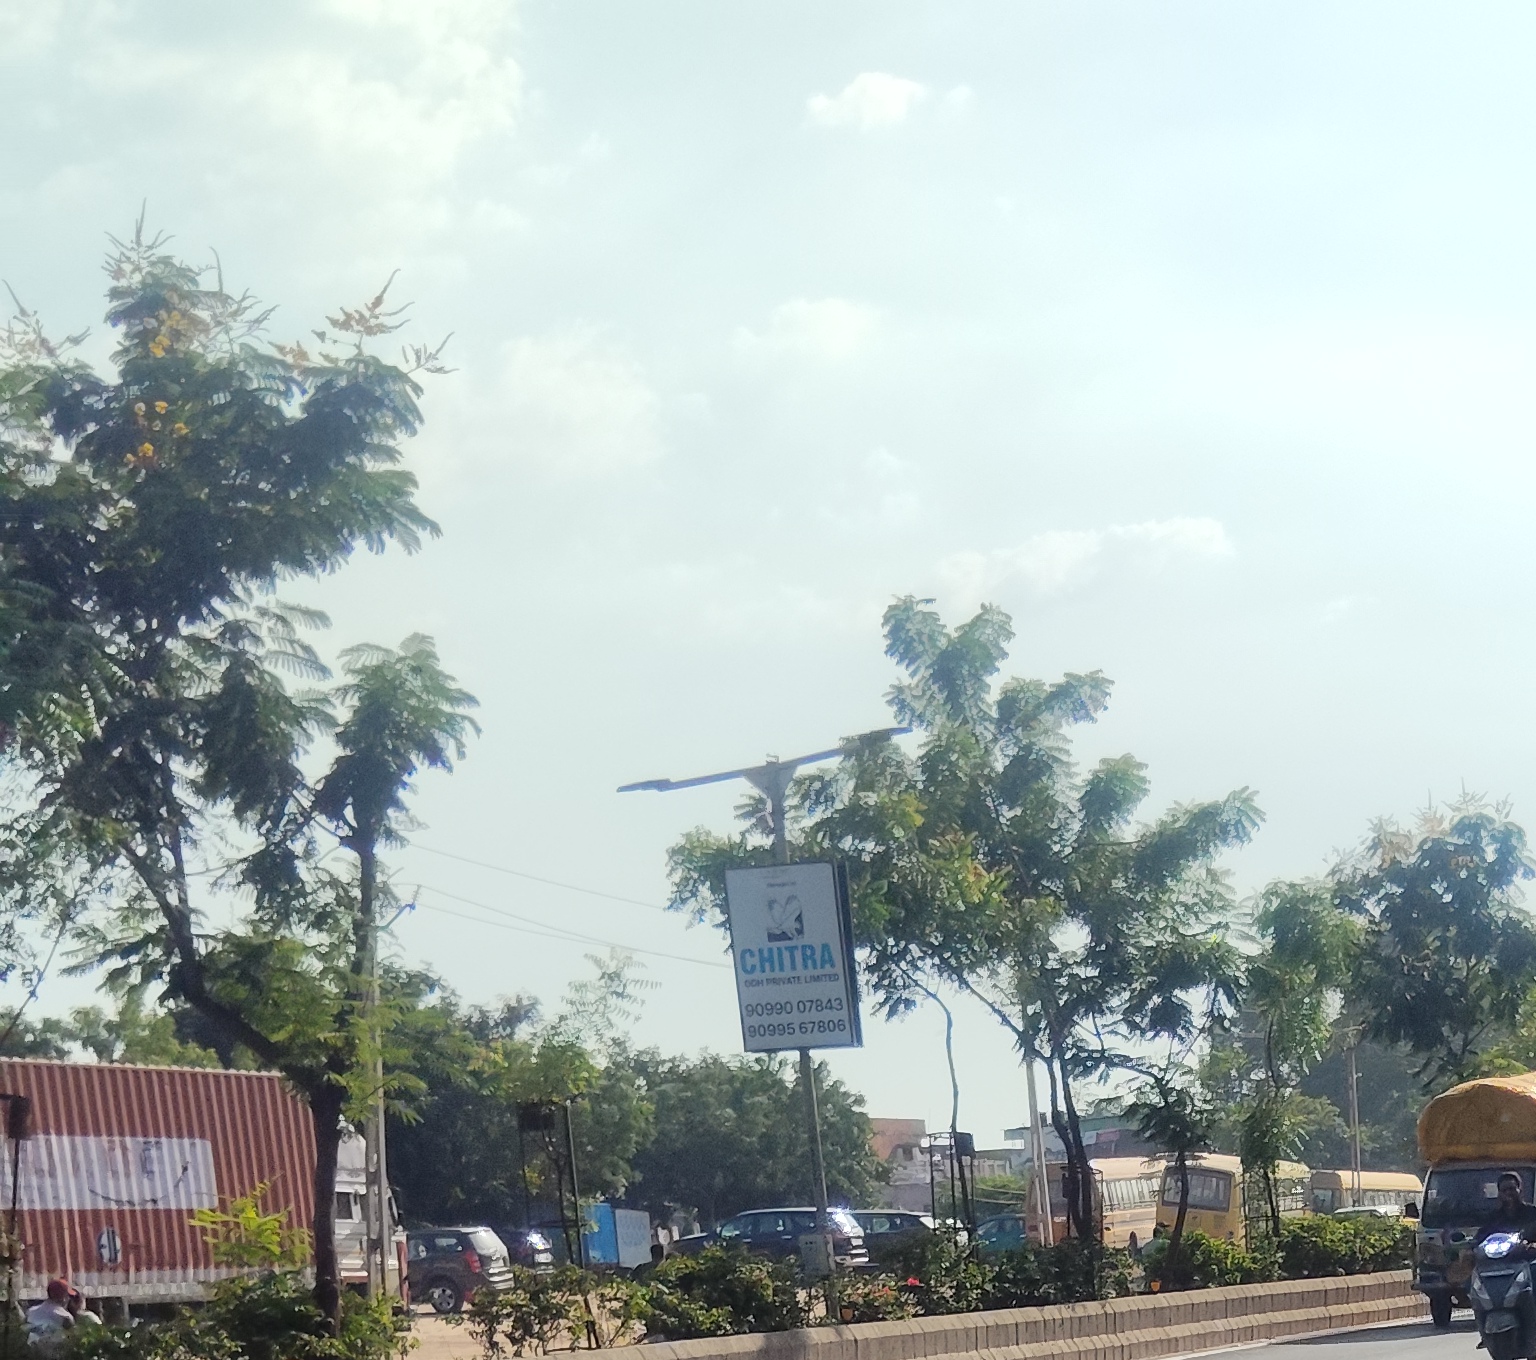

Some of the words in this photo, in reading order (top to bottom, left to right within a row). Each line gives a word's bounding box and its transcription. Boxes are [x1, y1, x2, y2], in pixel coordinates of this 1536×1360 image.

[740, 943, 836, 975] CHITRA
[765, 976, 802, 985] PRIVATE
[804, 973, 840, 984] LIMITED
[745, 1001, 793, 1017] 90990
[797, 997, 844, 1014] 07843
[748, 1022, 796, 1038] 90995
[799, 1019, 846, 1034] 67806
